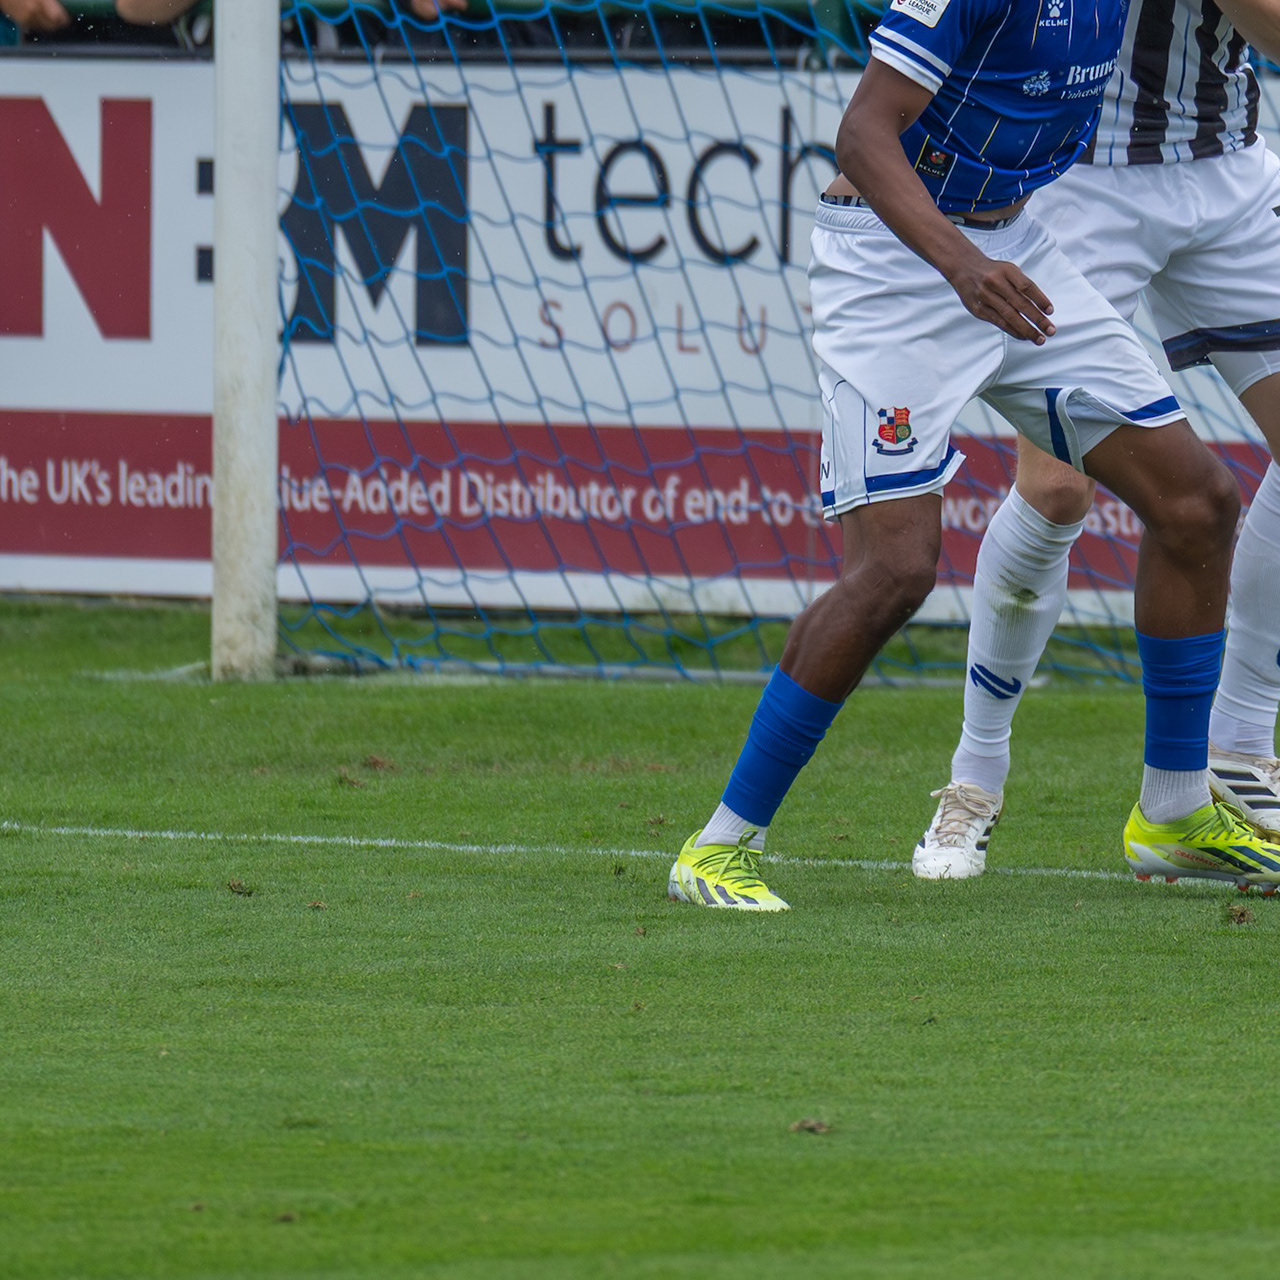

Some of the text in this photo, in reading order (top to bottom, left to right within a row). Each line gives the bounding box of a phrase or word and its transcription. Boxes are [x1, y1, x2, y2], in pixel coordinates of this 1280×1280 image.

[907, 0, 932, 16] LEAGUE
[1038, 17, 1069, 27] KELME
[0, 456, 39, 504] he
[47, 458, 111, 506] UK's
[119, 459, 213, 509] leadin
[280, 464, 451, 517] lue-Added
[459, 470, 635, 523] Distributor
[642, 473, 681, 523] of
